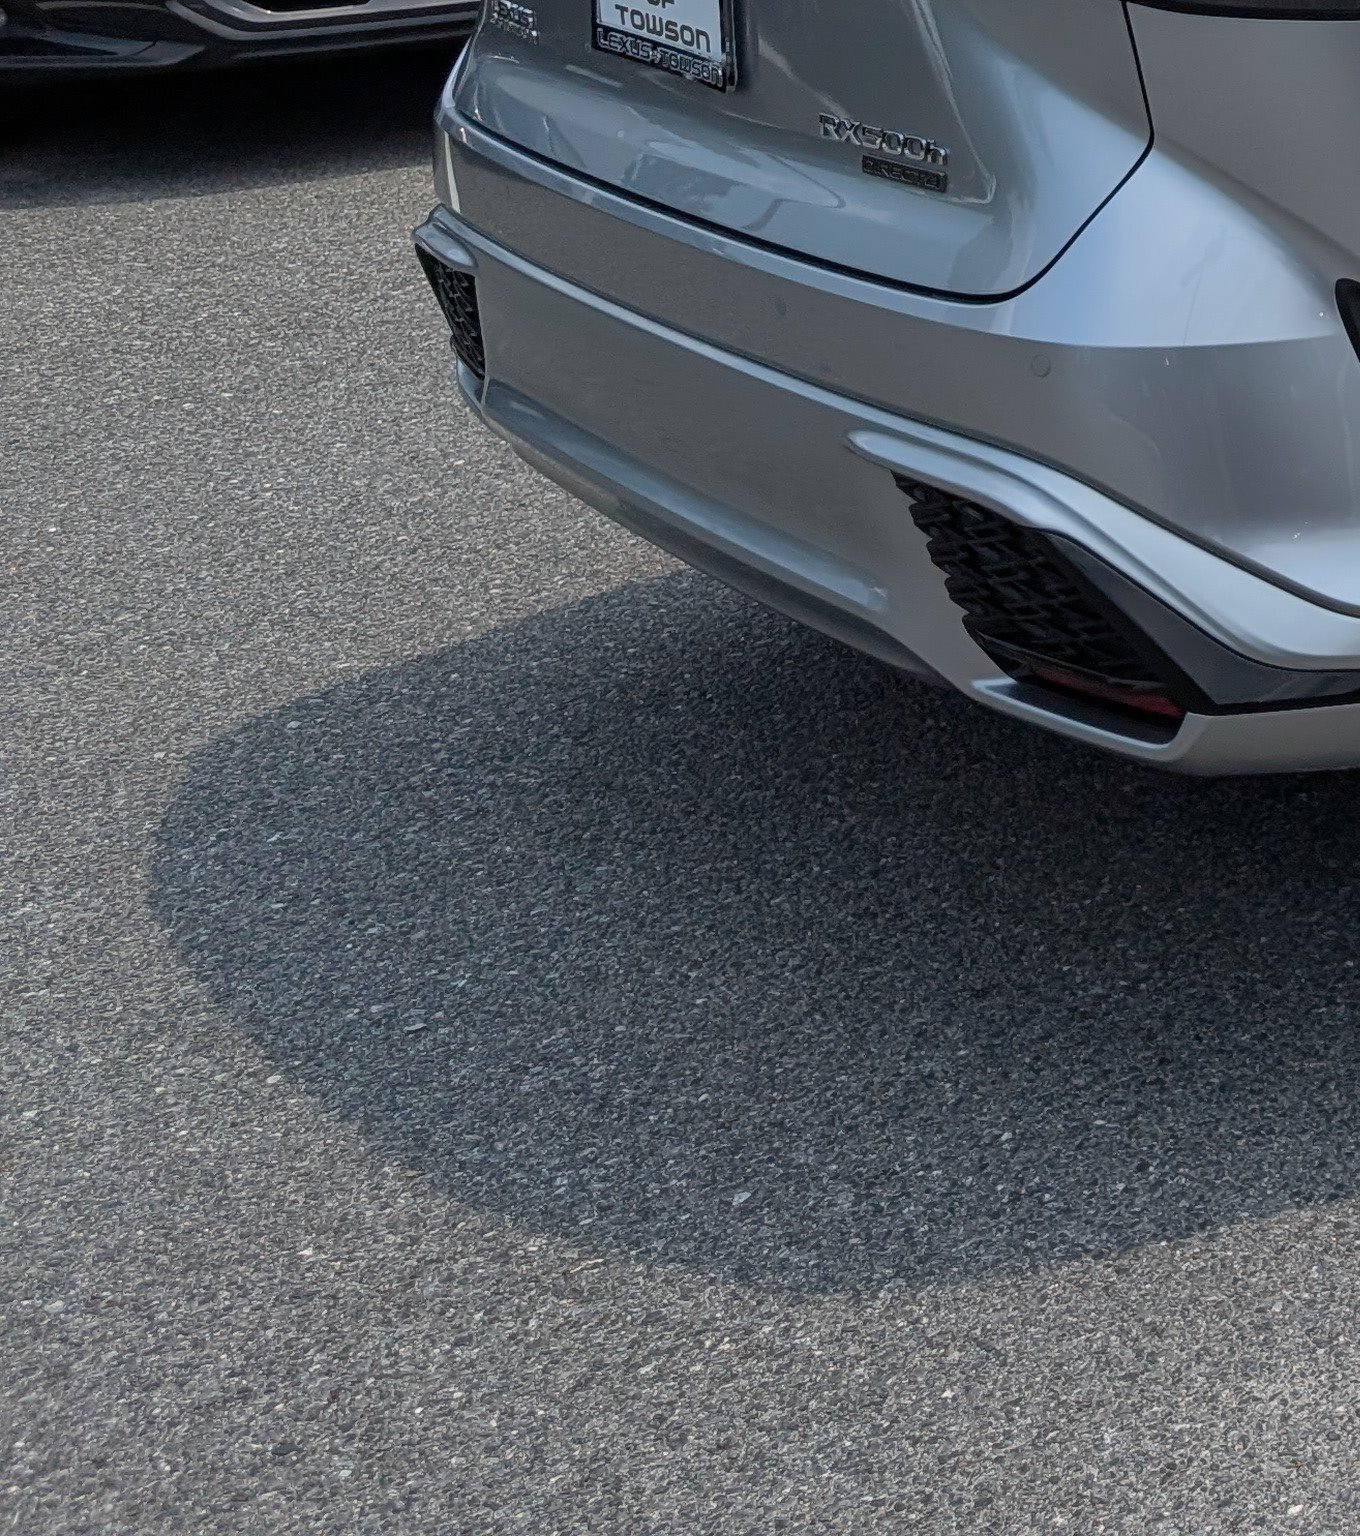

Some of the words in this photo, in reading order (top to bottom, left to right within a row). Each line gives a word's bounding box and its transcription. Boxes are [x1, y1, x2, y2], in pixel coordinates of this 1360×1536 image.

[597, 27, 653, 63] LEXUS
[614, 3, 711, 54] TOWSON
[818, 112, 949, 166] RX500h
